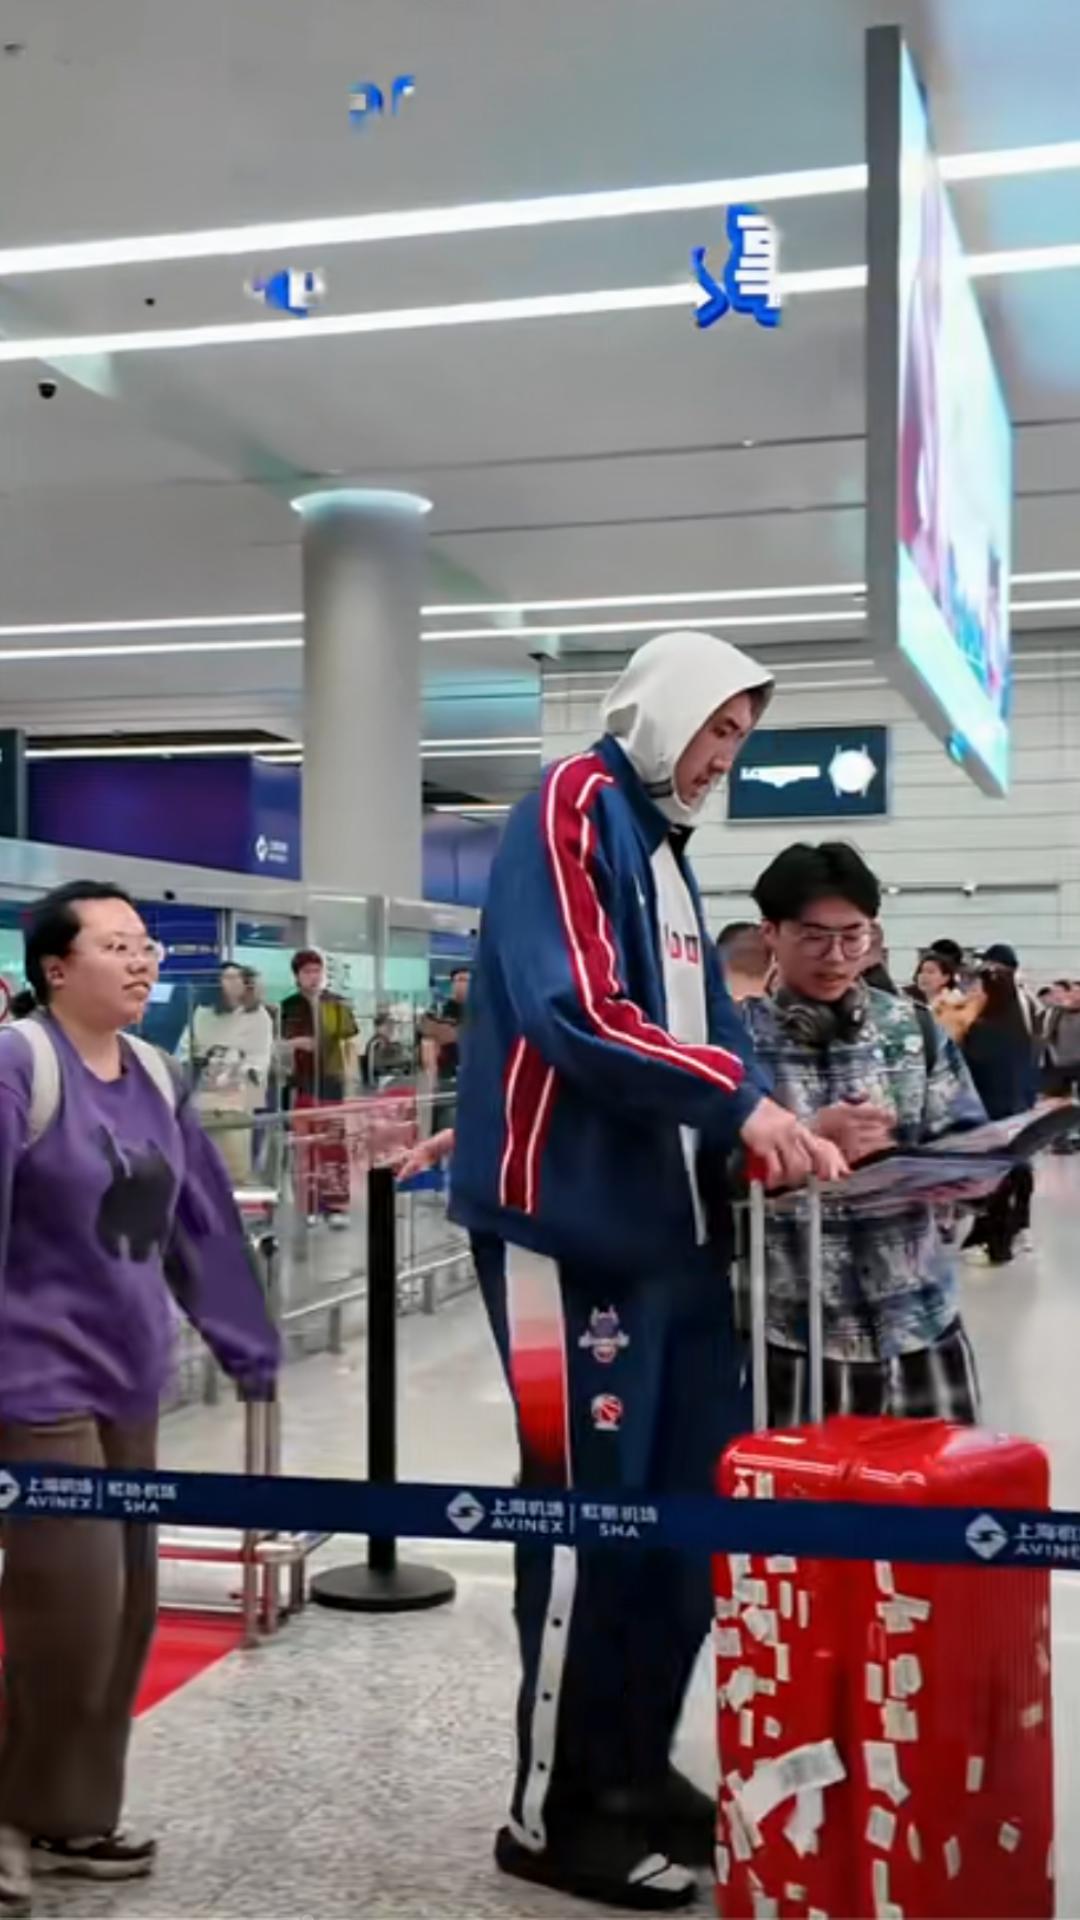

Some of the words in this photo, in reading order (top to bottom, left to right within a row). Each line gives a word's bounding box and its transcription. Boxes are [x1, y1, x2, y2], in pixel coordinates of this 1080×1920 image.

[25, 1496, 92, 1510] AVINEX
[123, 1499, 160, 1514] SHA
[491, 1516, 564, 1534] AVINEX
[599, 1522, 640, 1538] SHA
